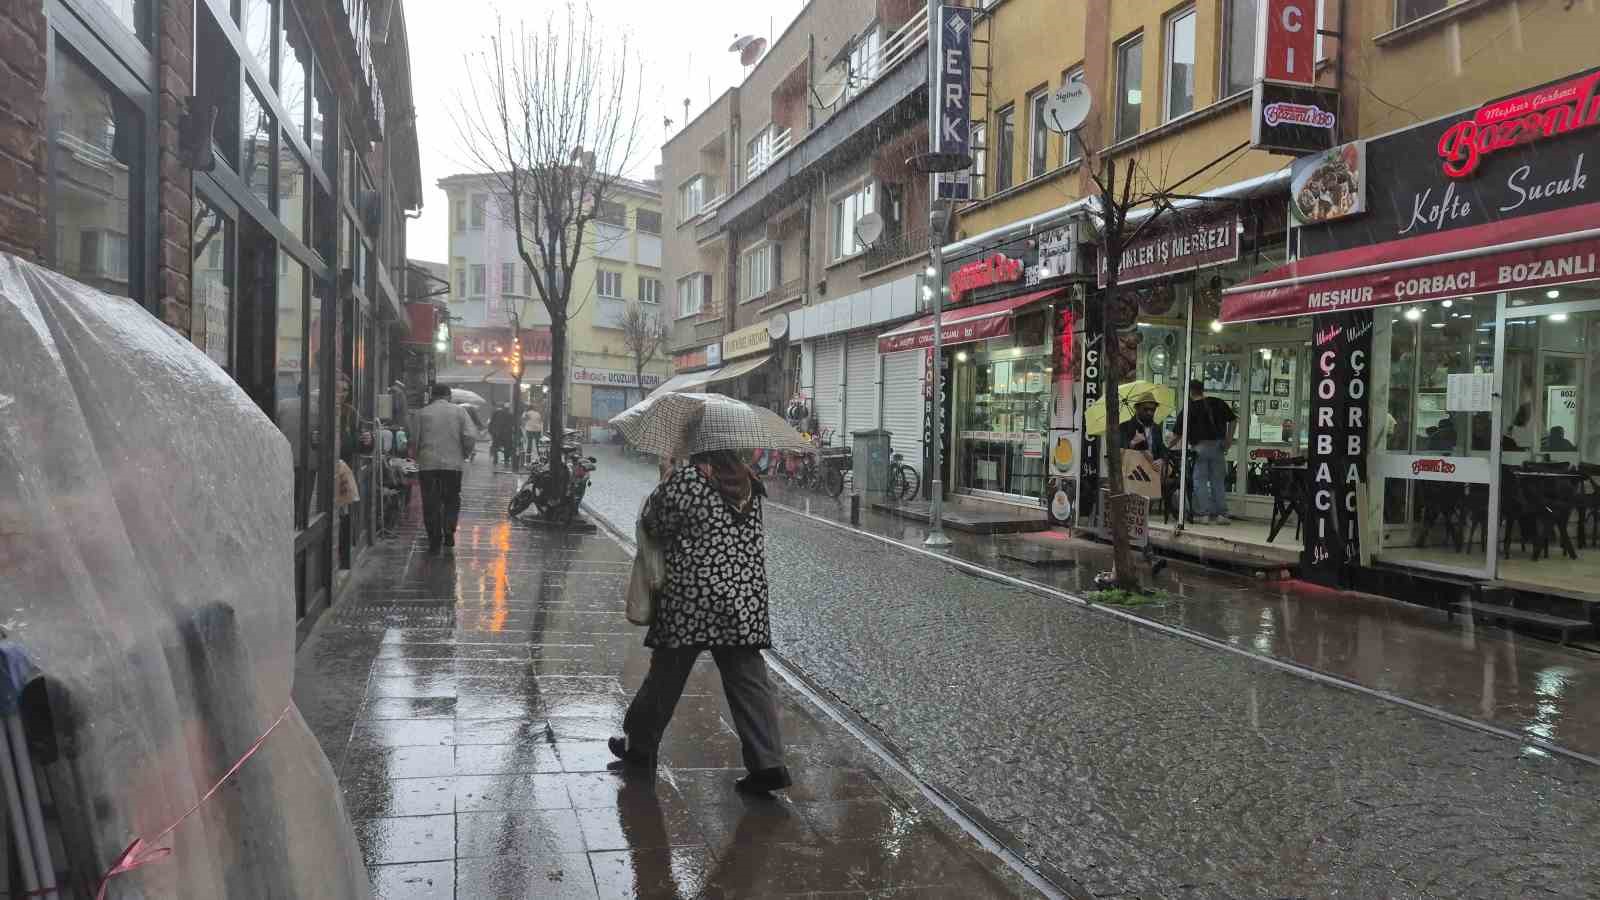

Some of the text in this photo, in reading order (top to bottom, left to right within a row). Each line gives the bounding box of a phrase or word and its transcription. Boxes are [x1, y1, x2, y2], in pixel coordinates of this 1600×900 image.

[943, 49, 964, 142] ERK
[1500, 152, 1588, 212] Sucuk
[1172, 222, 1230, 258] MERKEZİ
[1308, 286, 1373, 311] MEŞHUR
[1394, 272, 1476, 300] ÇORBACI
[1497, 253, 1595, 284] BOZANLI
[1314, 350, 1336, 538] ÇORBACI
